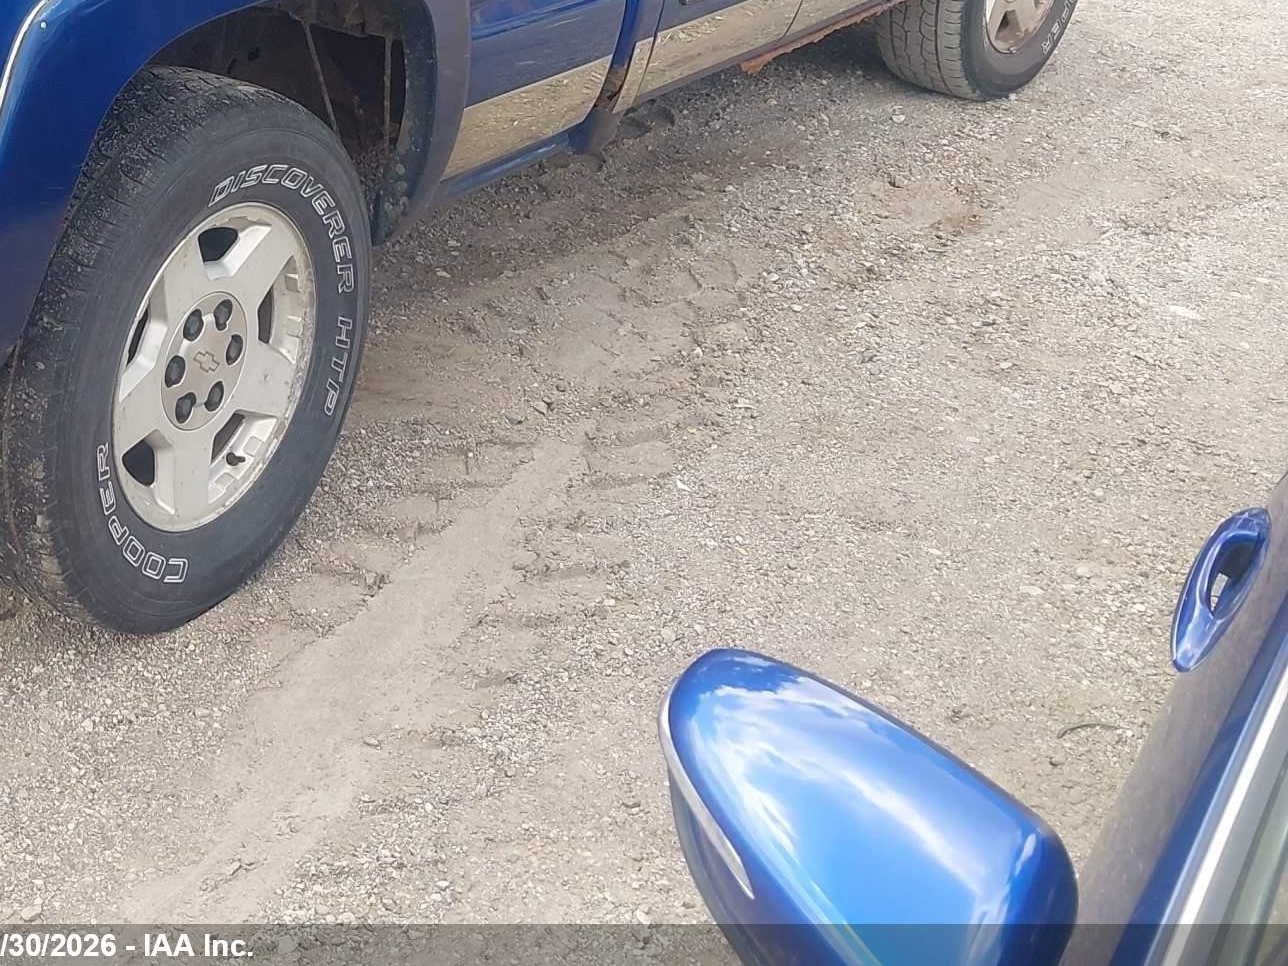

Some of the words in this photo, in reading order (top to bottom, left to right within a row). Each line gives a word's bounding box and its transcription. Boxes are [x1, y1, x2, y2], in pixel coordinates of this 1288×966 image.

[209, 164, 355, 295] DISCOVERER
[324, 315, 353, 416] HTP
[97, 443, 188, 584] COOPER
